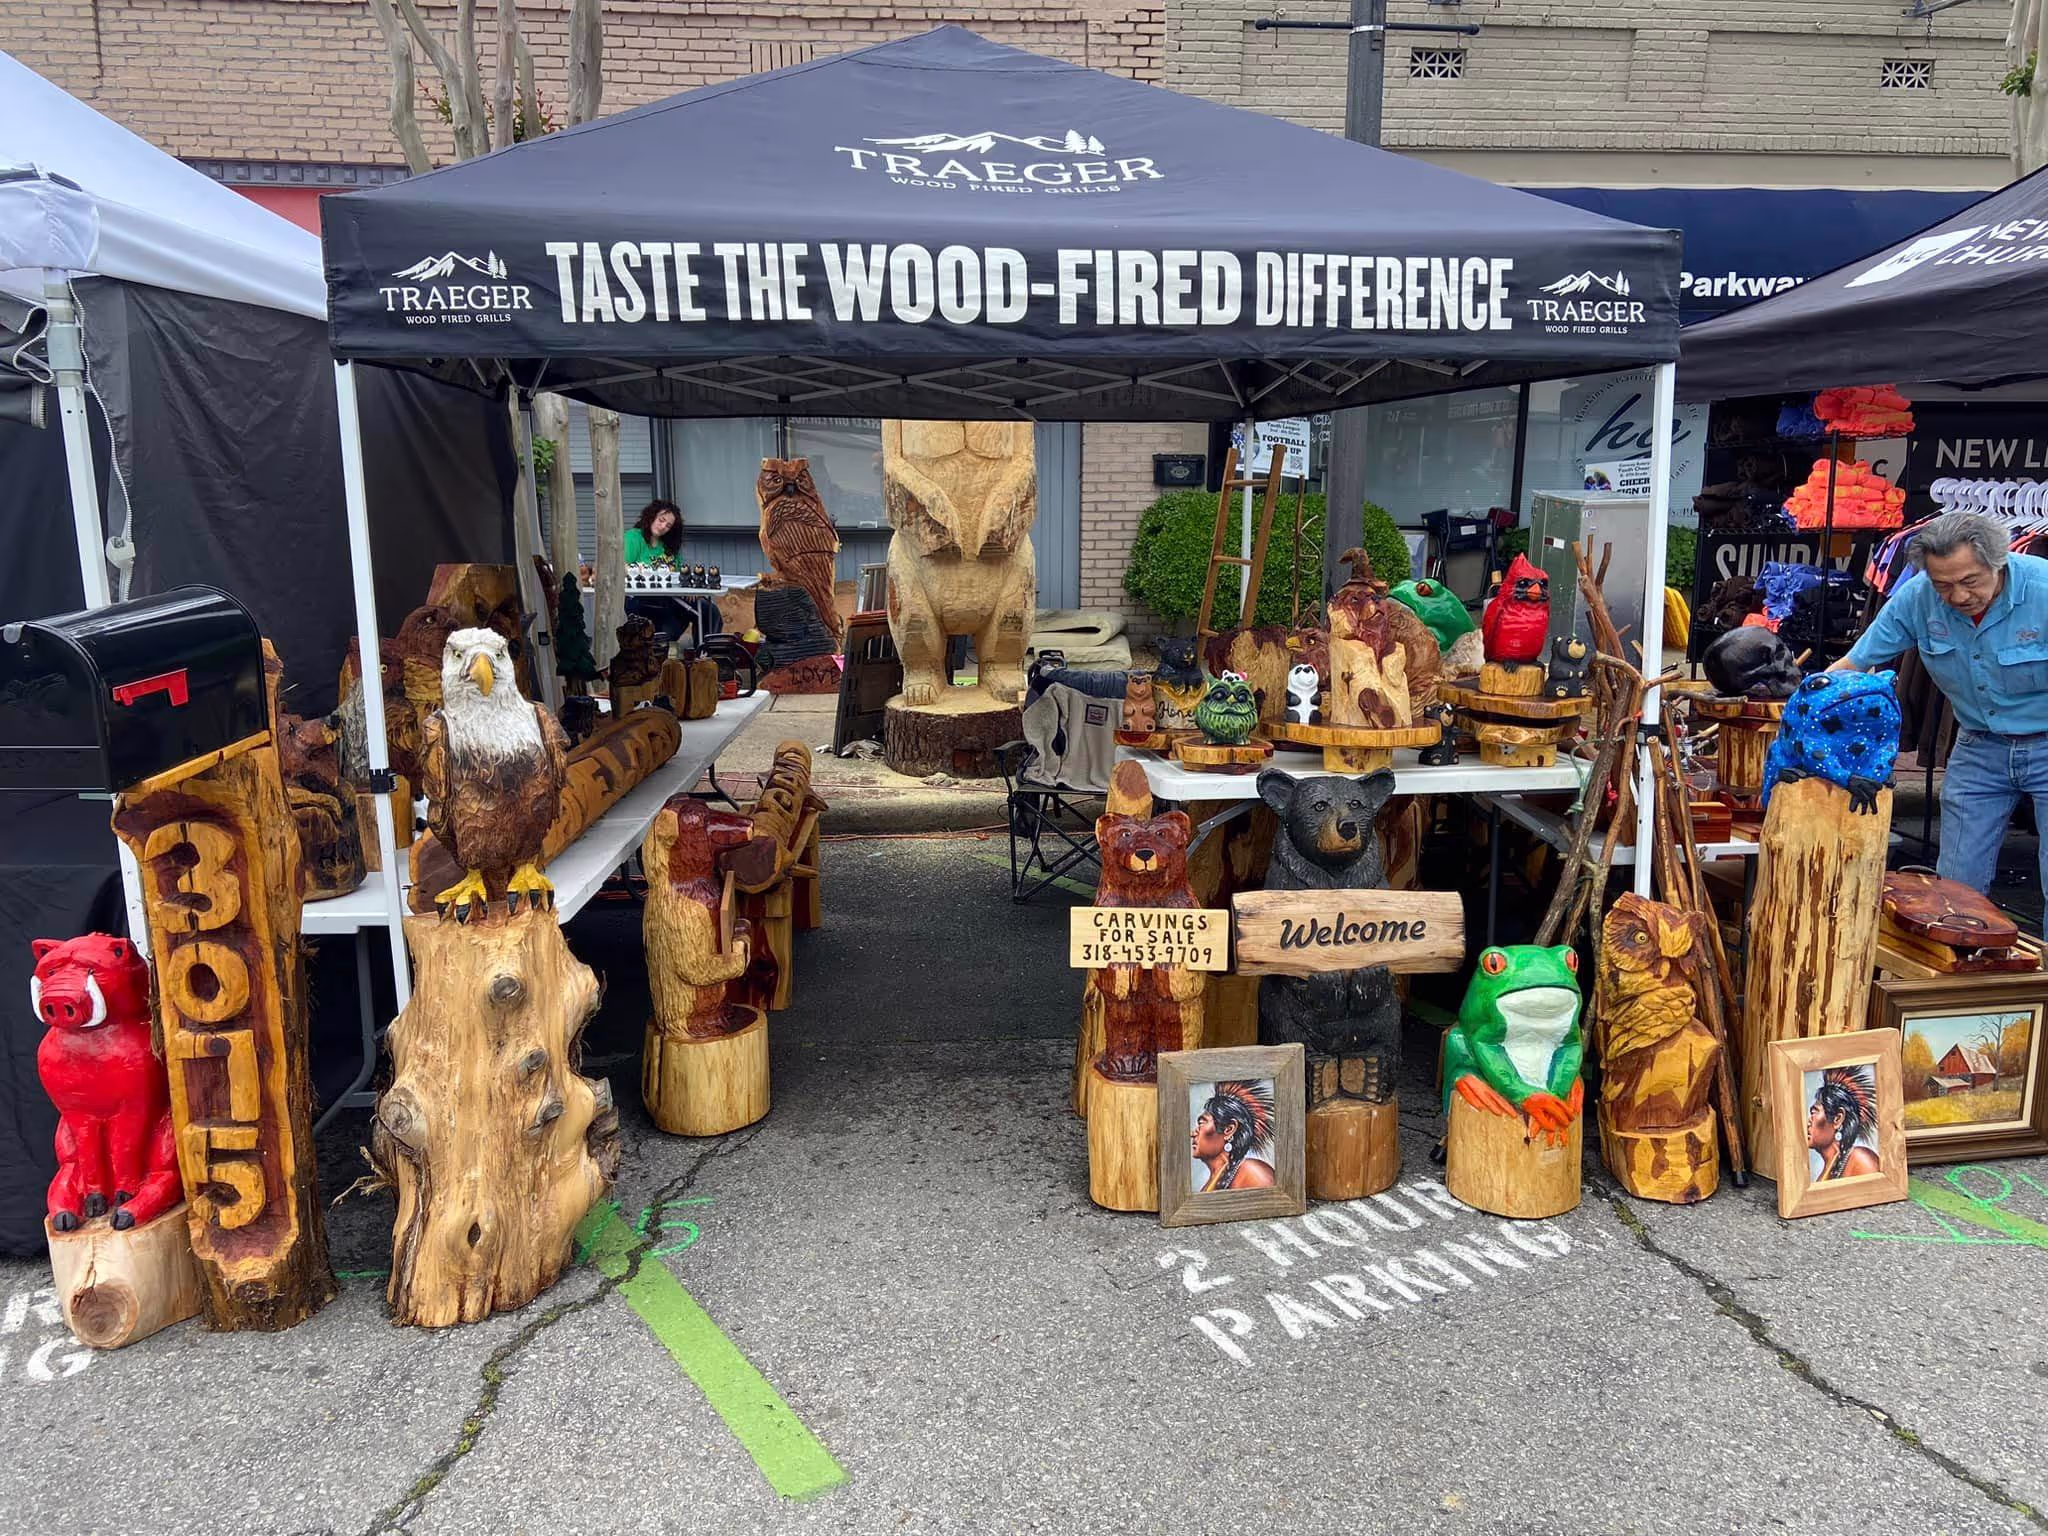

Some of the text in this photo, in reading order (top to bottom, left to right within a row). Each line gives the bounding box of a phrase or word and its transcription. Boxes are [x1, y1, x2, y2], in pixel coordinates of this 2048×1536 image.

[834, 145, 1165, 184] TRAEGER
[890, 176, 1121, 193] WOOD FIRED GRILLS
[545, 241, 1514, 331] TASTE THE WOOD-FIRED DIFFERENCE
[1680, 271, 1816, 298] Parkwa
[379, 285, 533, 312] TRAEGER
[1527, 299, 1646, 323] TRAEGER
[405, 313, 512, 325] WOOD FIRED GRILLS
[1545, 325, 1628, 335] WOOD FIRED GRILLS
[1262, 434, 1307, 447] FOOTBALL
[1936, 438, 2019, 468] NEW
[1093, 912, 1208, 930] CARVINGS
[1278, 911, 1427, 950] Welcome
[1100, 928, 1196, 945] FOR SALE
[1082, 943, 1213, 964] 318-453-9709
[1158, 1174, 1477, 1294] 2 HOUR
[1190, 1218, 1574, 1367] PARKING
